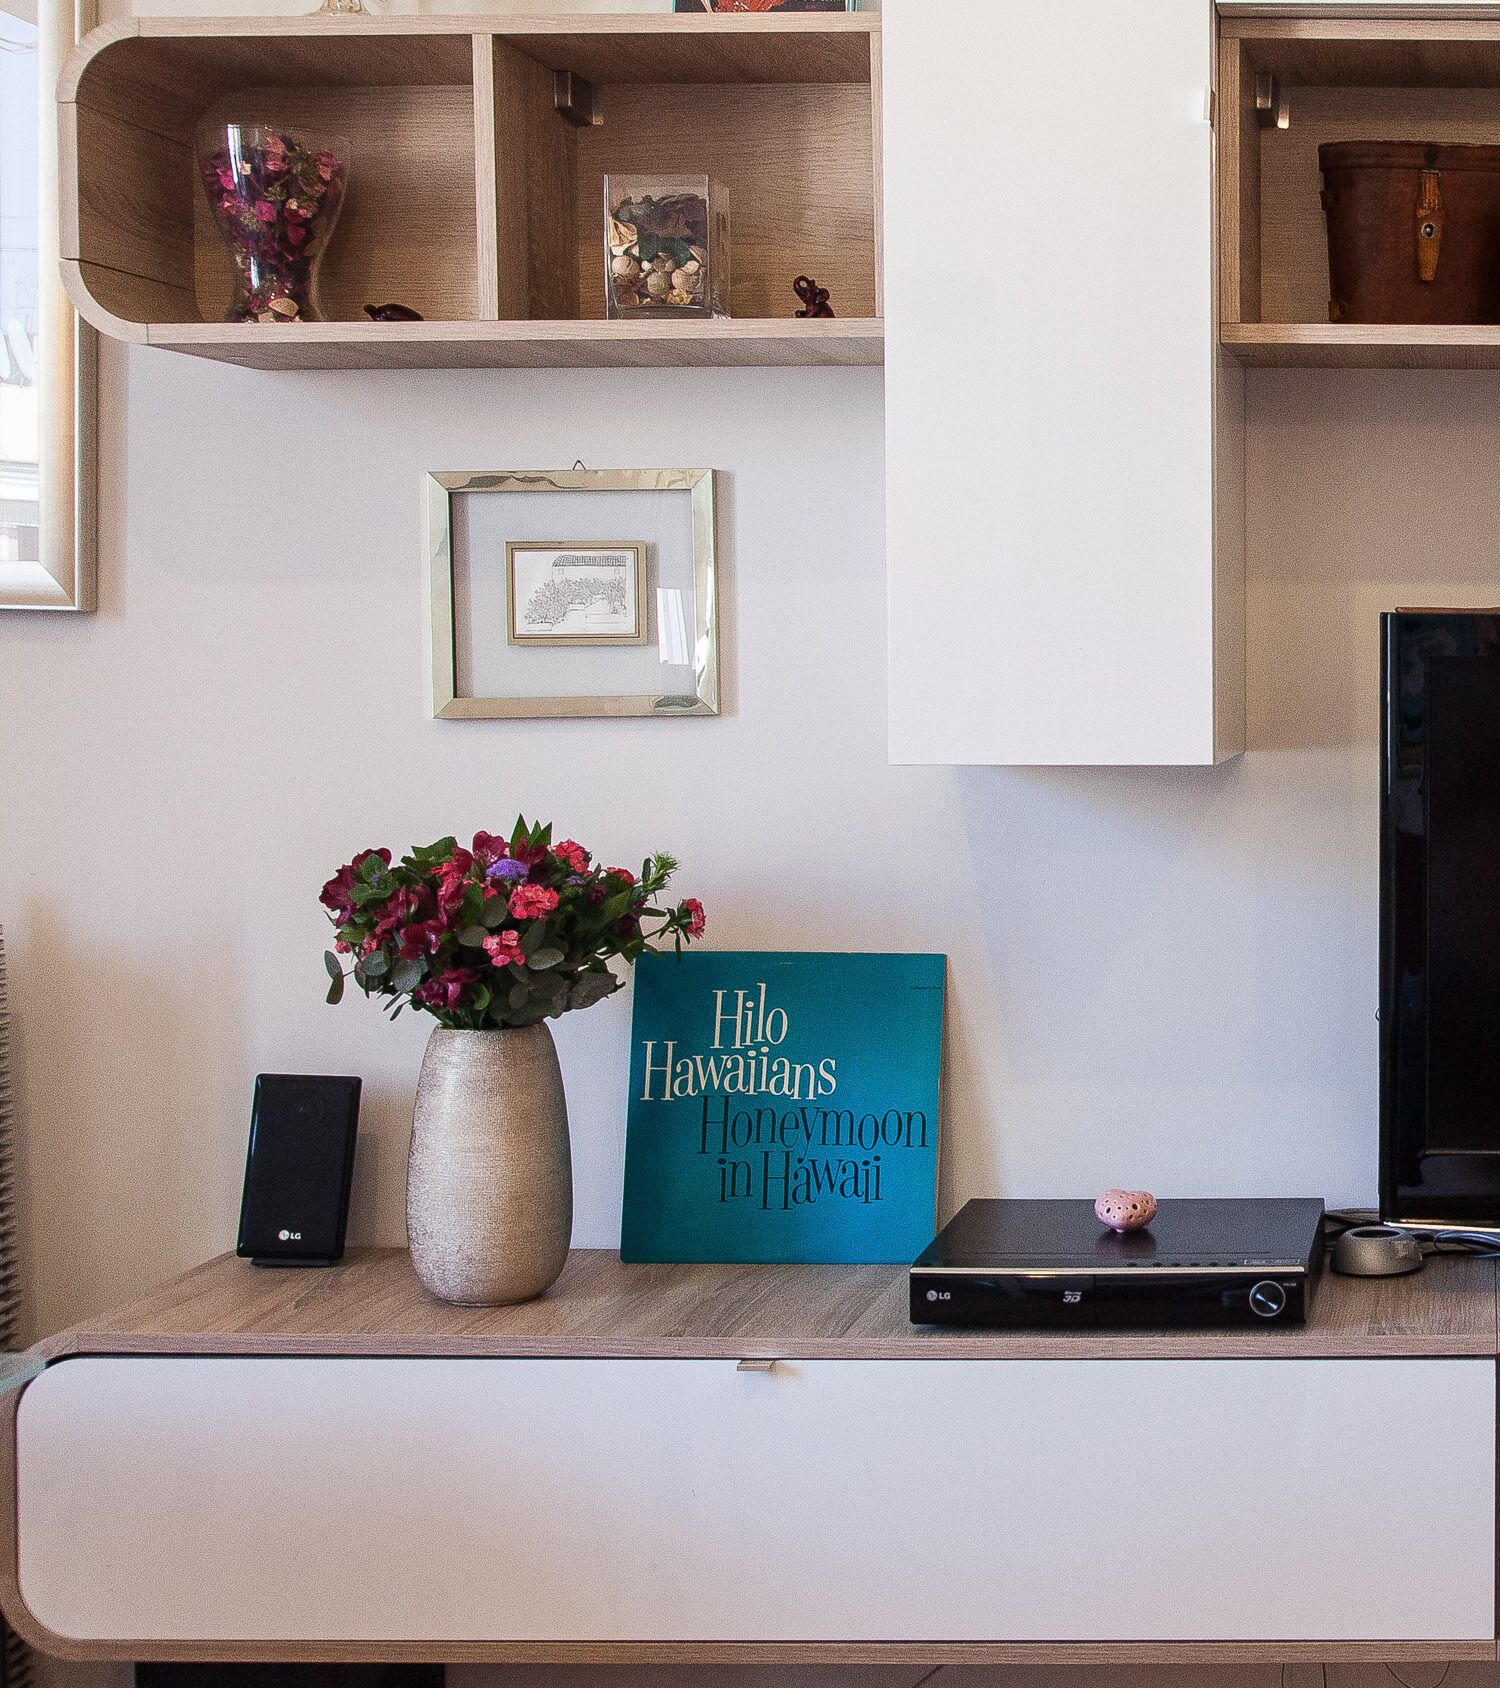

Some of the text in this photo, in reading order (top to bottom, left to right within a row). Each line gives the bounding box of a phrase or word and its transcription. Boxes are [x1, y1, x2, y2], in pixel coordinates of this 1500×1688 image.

[710, 983, 789, 1049] Hilo
[639, 1041, 837, 1101] Hawaiians
[697, 1095, 930, 1156] Honeymoon
[717, 1151, 884, 1211] in Hawaii
